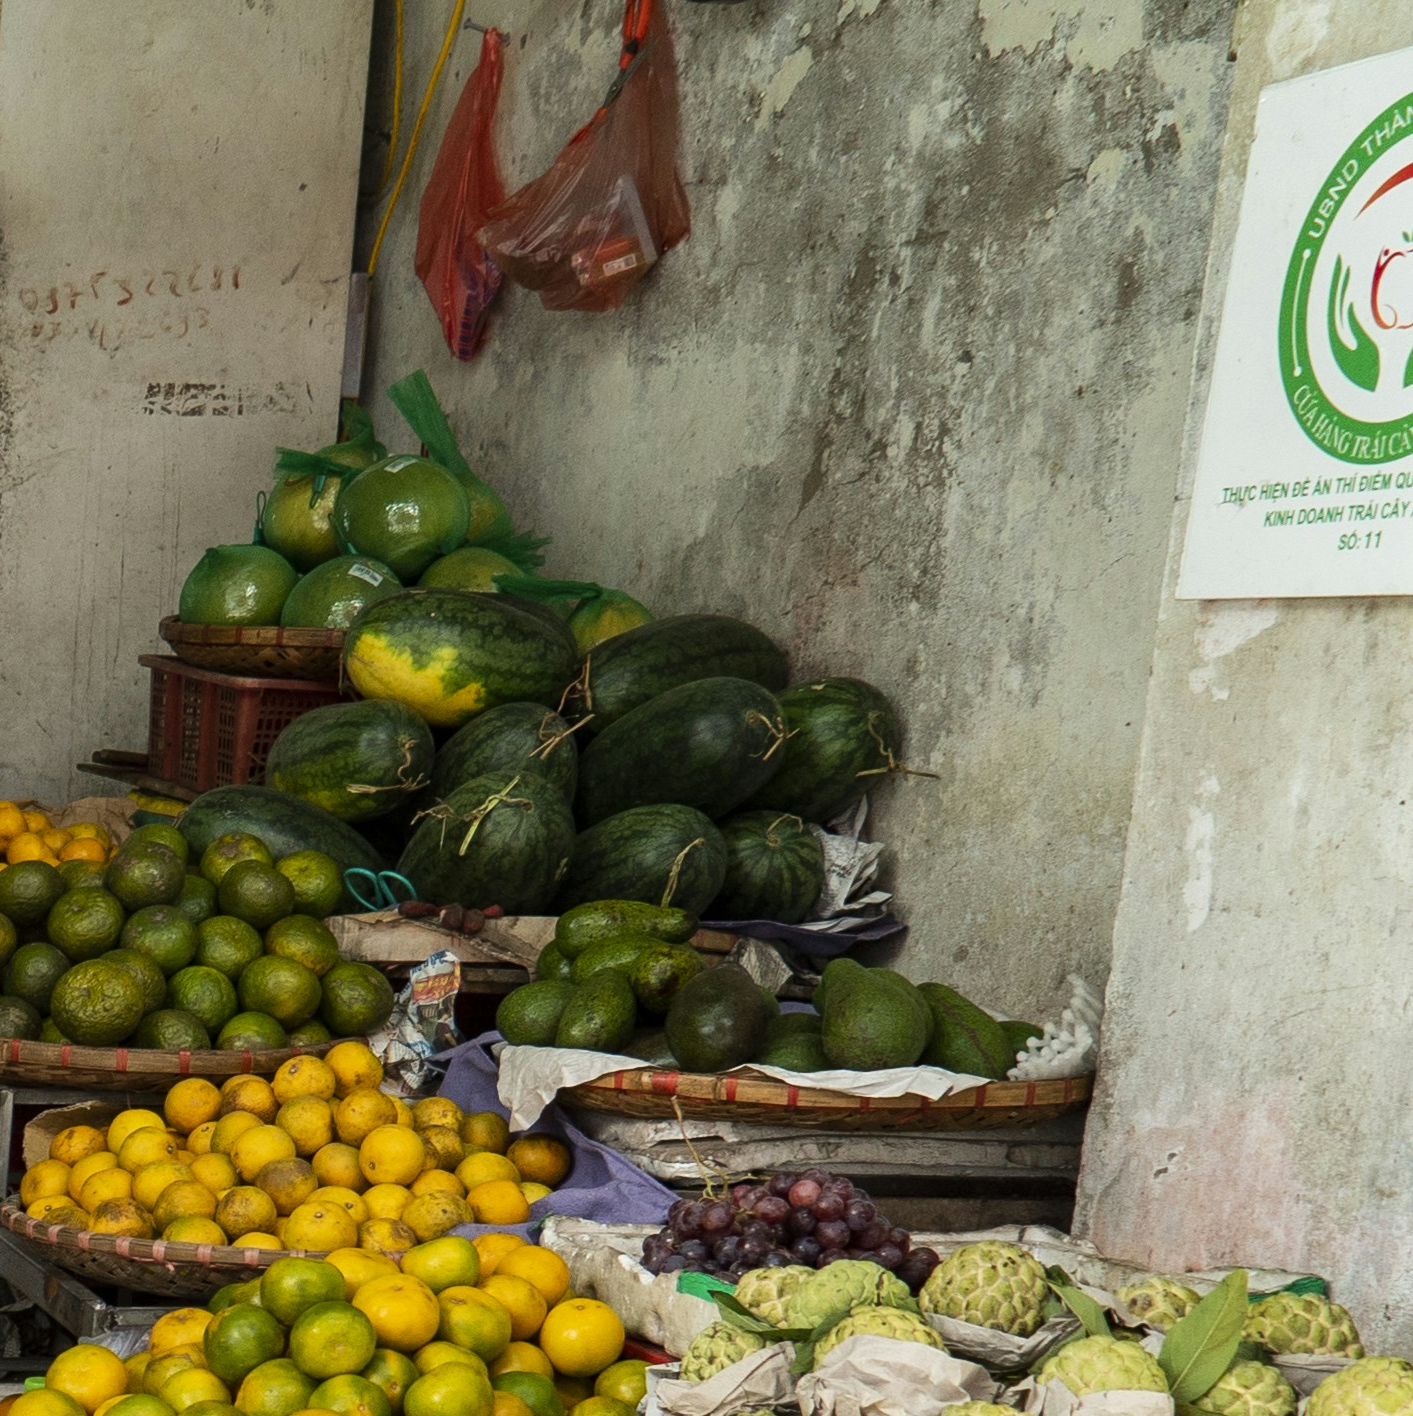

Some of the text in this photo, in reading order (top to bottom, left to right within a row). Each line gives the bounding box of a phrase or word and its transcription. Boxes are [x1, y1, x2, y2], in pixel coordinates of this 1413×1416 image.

[1308, 159, 1359, 239] UBND
[1293, 384, 1413, 459] CỬA HÀNG TRÁI CÂ
[1259, 480, 1290, 503] HIỆN
[1312, 475, 1332, 495] ÁN
[1335, 471, 1358, 494] THÍ
[1264, 497, 1410, 527] KINH DOANH TRÁI CÂY
[1364, 530, 1383, 550] 11
